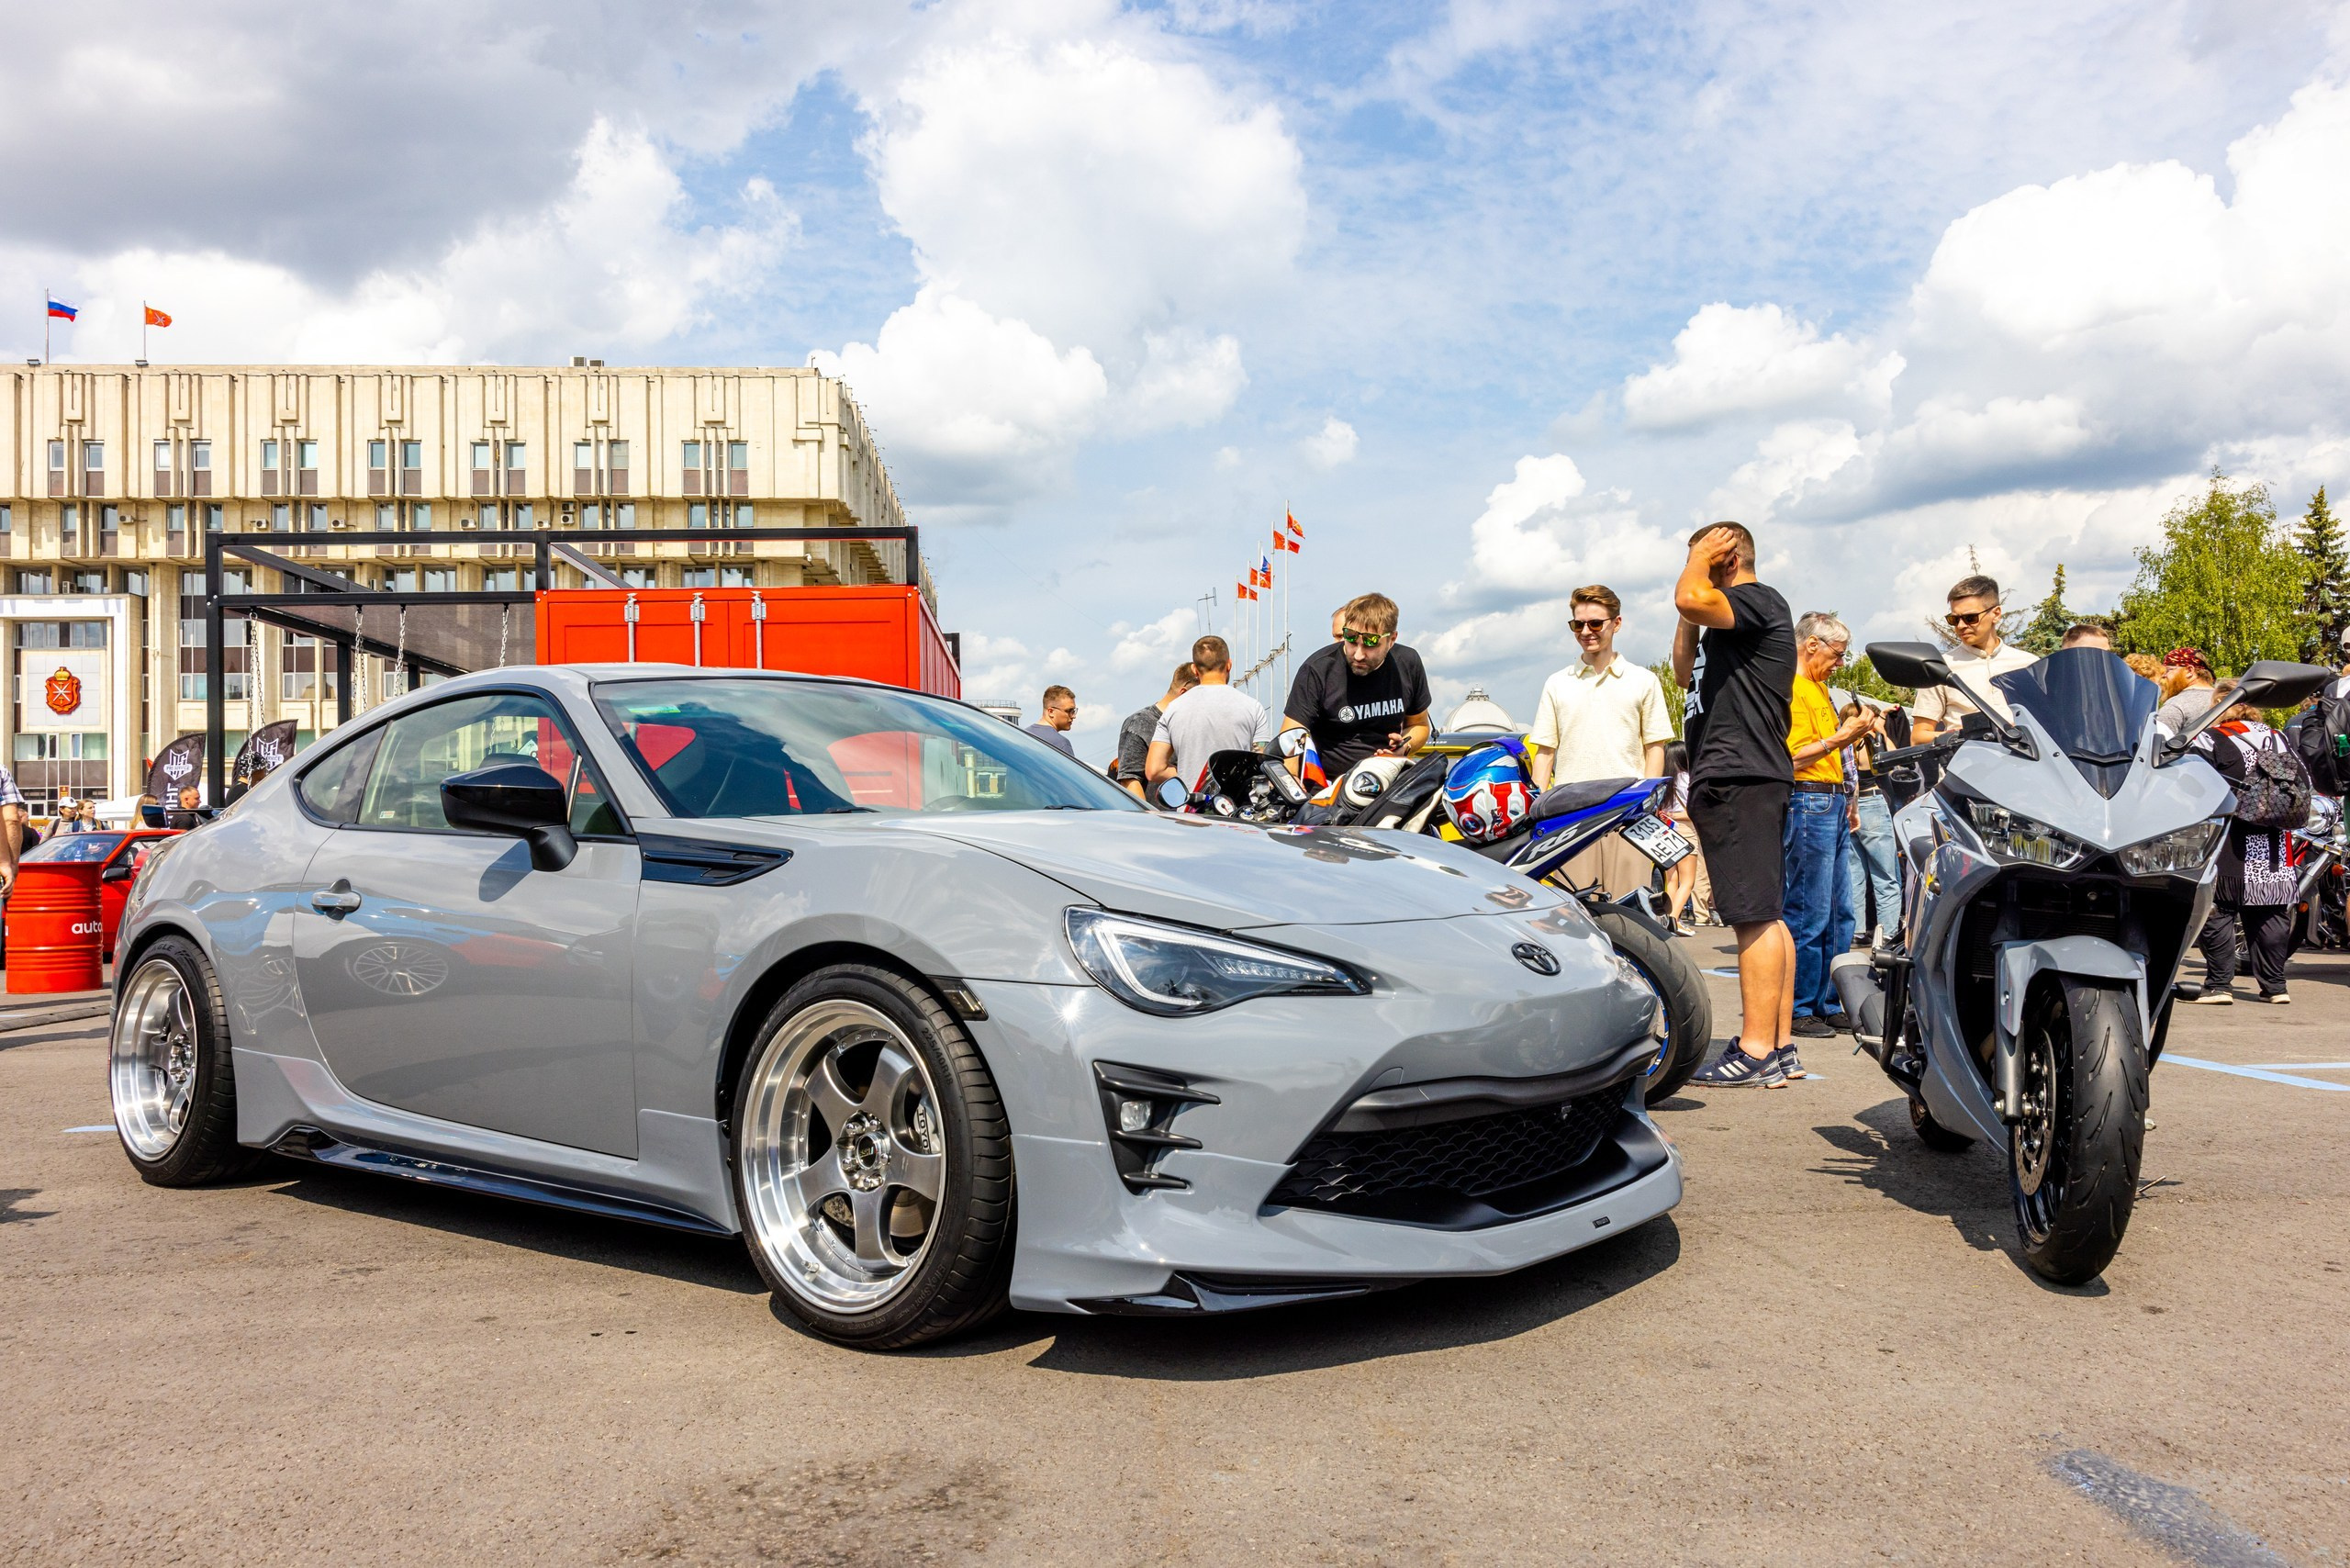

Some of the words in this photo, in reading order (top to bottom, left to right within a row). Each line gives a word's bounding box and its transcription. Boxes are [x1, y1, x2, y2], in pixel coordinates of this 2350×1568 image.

[1354, 698, 1404, 720] YAMAHA
[1526, 823, 1582, 862] R6
[1629, 818, 1661, 841] 3135
[1651, 843, 1673, 861] AE
[1664, 834, 1685, 849] 71
[72, 921, 103, 935] auto
[922, 1027, 954, 1086] 225/40R18
[918, 1109, 929, 1153] TOYO
